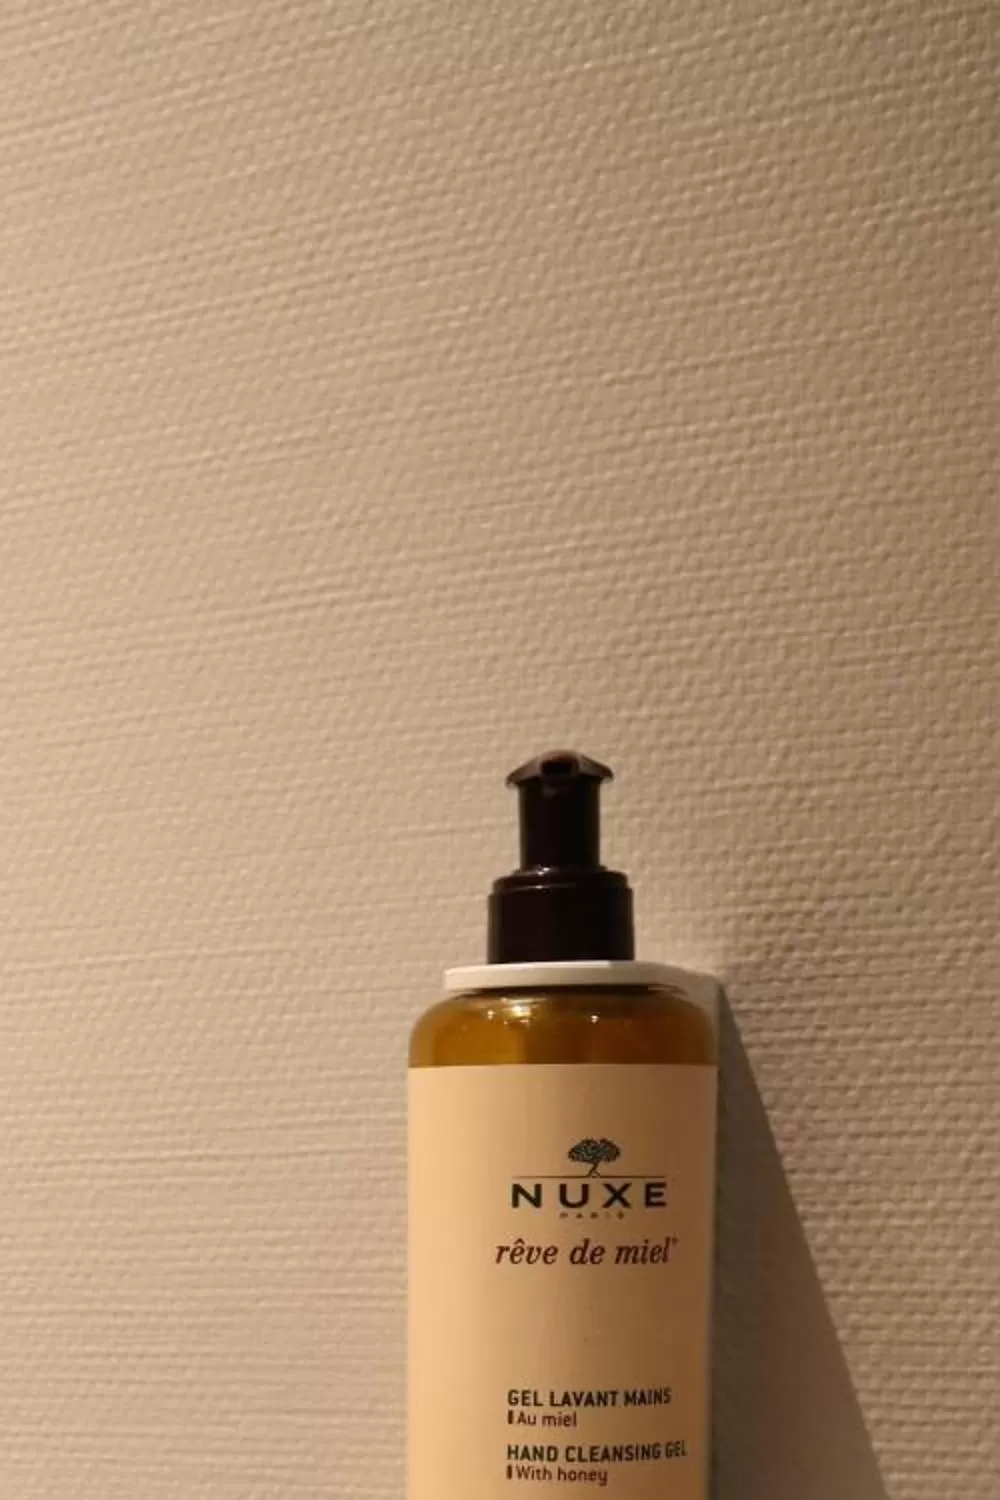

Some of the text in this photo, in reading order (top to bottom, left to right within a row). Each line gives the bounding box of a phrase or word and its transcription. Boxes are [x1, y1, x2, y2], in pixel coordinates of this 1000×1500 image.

[511, 1182, 667, 1208] NUXE
[495, 1238, 559, 1265] rêve
[569, 1237, 606, 1265] de
[507, 1387, 673, 1408] GEL LAVANT MAINS
[517, 1411, 577, 1428] Au miel
[507, 1439, 687, 1463] HAND CLEANSING GEL
[516, 1465, 608, 1486] With honey
